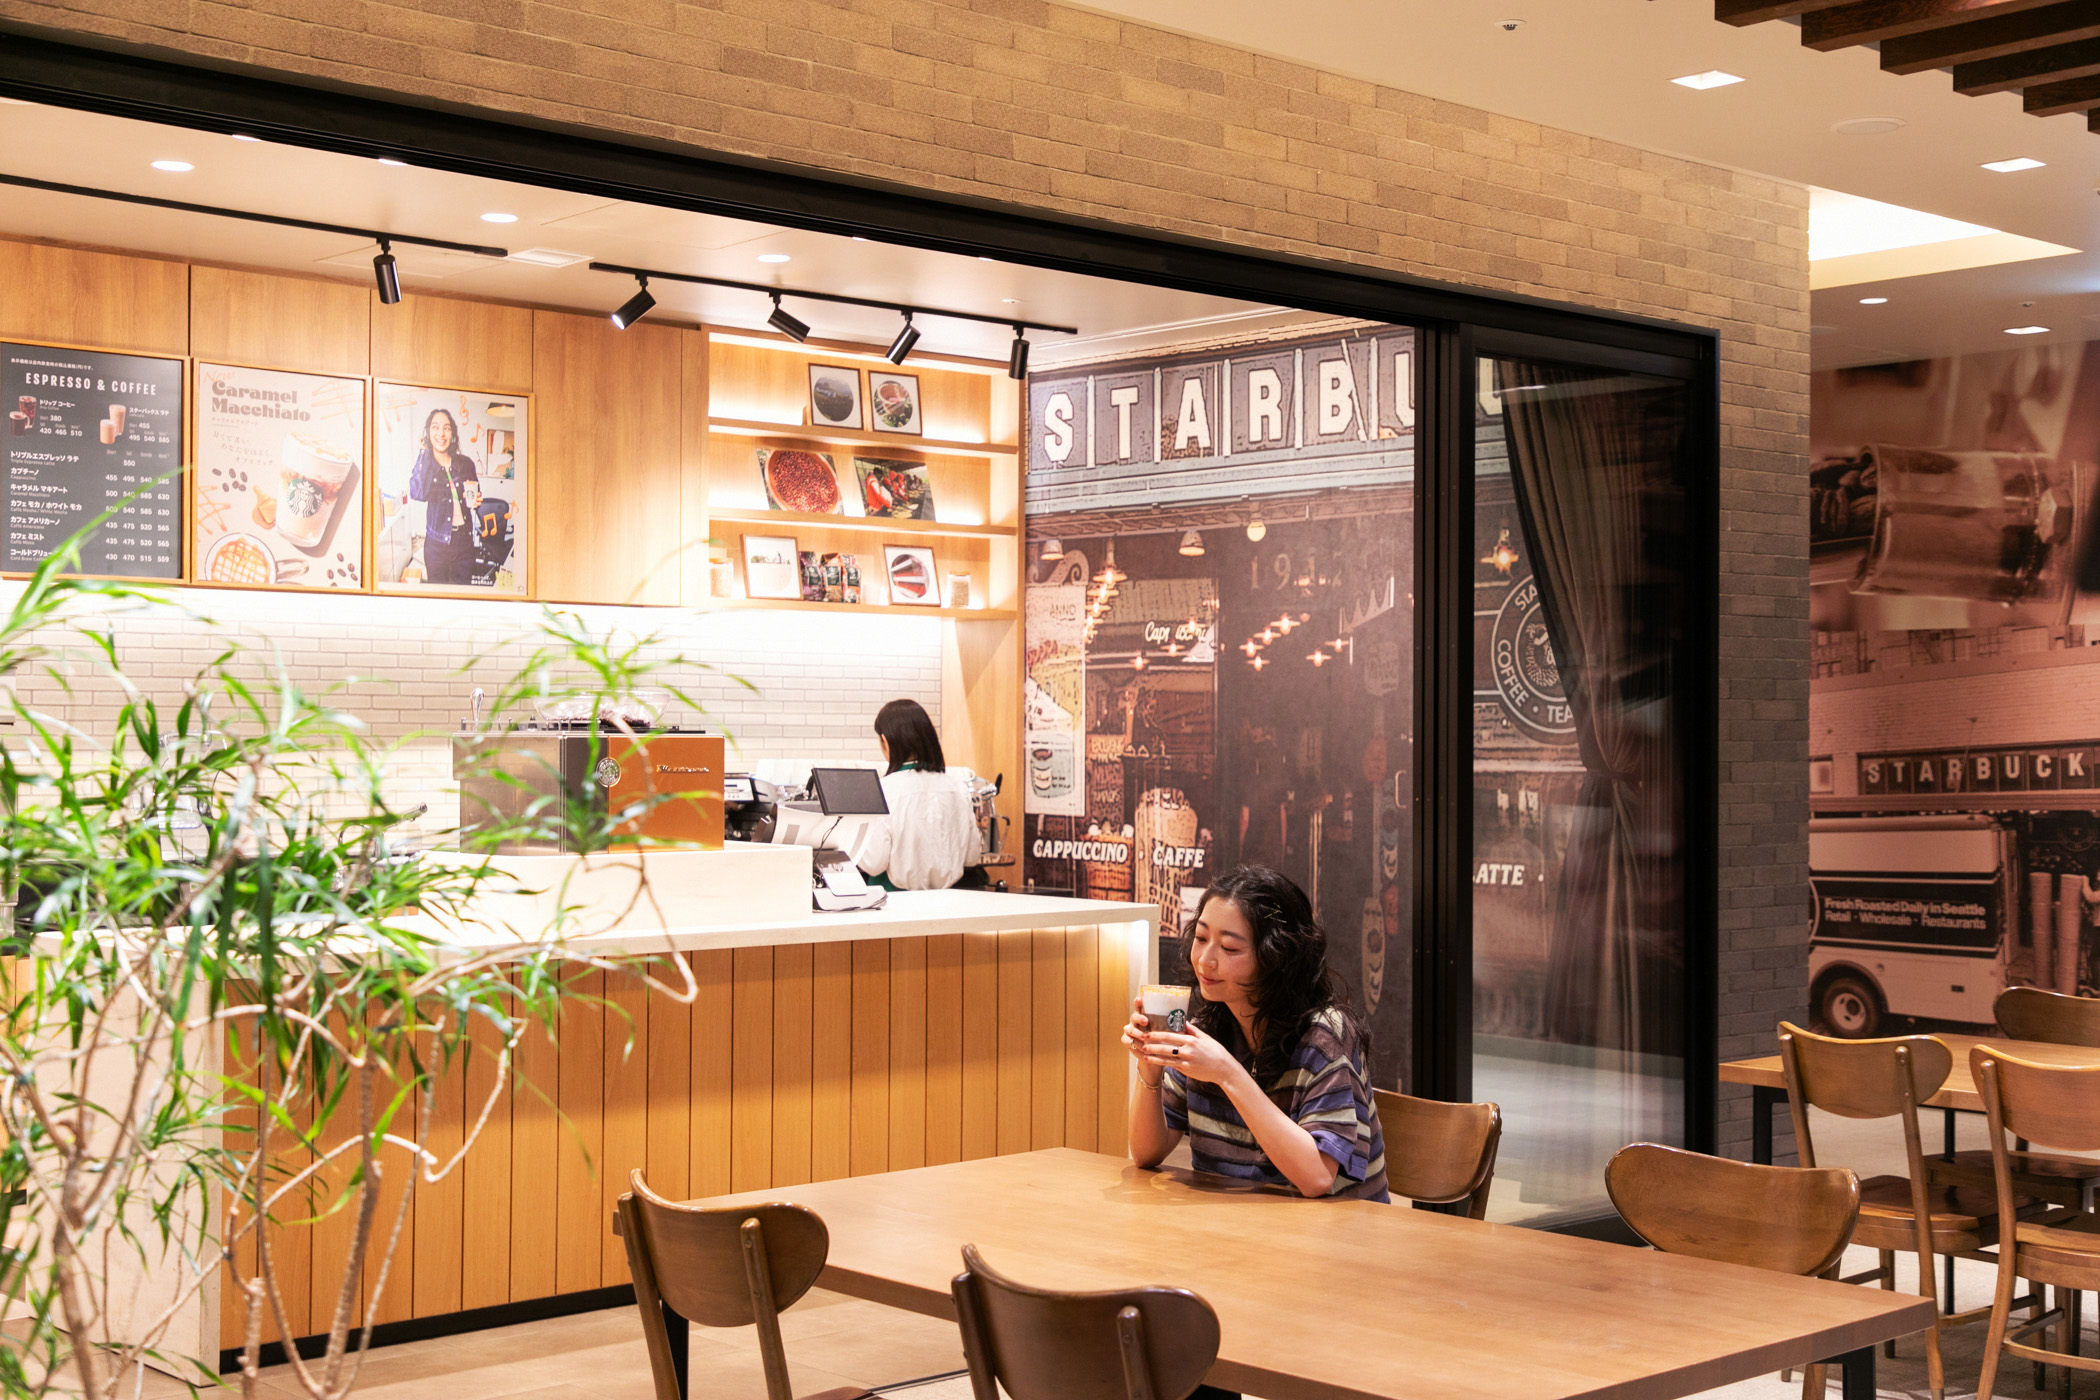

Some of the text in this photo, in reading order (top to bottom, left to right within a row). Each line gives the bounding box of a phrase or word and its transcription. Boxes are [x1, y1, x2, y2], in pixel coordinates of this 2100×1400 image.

[25, 372, 157, 396] ESPRESSO & COFFEE
[211, 379, 298, 404] Caramel
[211, 397, 311, 422] Macchiato
[39, 427, 52, 435] 420
[143, 435, 156, 443] 540
[66, 455, 80, 463] ラテ
[123, 475, 136, 483] 495
[140, 476, 152, 484] 540
[10, 483, 68, 494] キャラメル マキアート
[157, 493, 170, 501] 630
[10, 499, 27, 507] カフェ
[28, 500, 41, 508] モカ
[45, 502, 69, 510] ホワイト
[70, 503, 83, 511] モカ
[10, 515, 61, 526] カフェ アメリカーノ
[123, 522, 136, 530] 475
[140, 523, 153, 531] 520
[157, 524, 170, 532] 565
[10, 532, 45, 541] カフェ ミスト
[105, 537, 170, 548] 435 475 520 565
[105, 553, 118, 561] 430
[123, 554, 136, 562] 470
[1497, 639, 1529, 707] COFFEE
[1547, 704, 1574, 723] TEA
[1867, 751, 2085, 784] STARBUCK
[1032, 838, 1206, 868] CAPPUCCINO CAFFE
[1473, 862, 1525, 886] ATTE
[1824, 898, 1854, 910] Fresh
[1855, 899, 1900, 912] Roasted
[1901, 901, 1928, 914] Daily
[1942, 903, 1986, 916] Seattle
[1824, 910, 1987, 930] Retail Wholesale Restaurants
